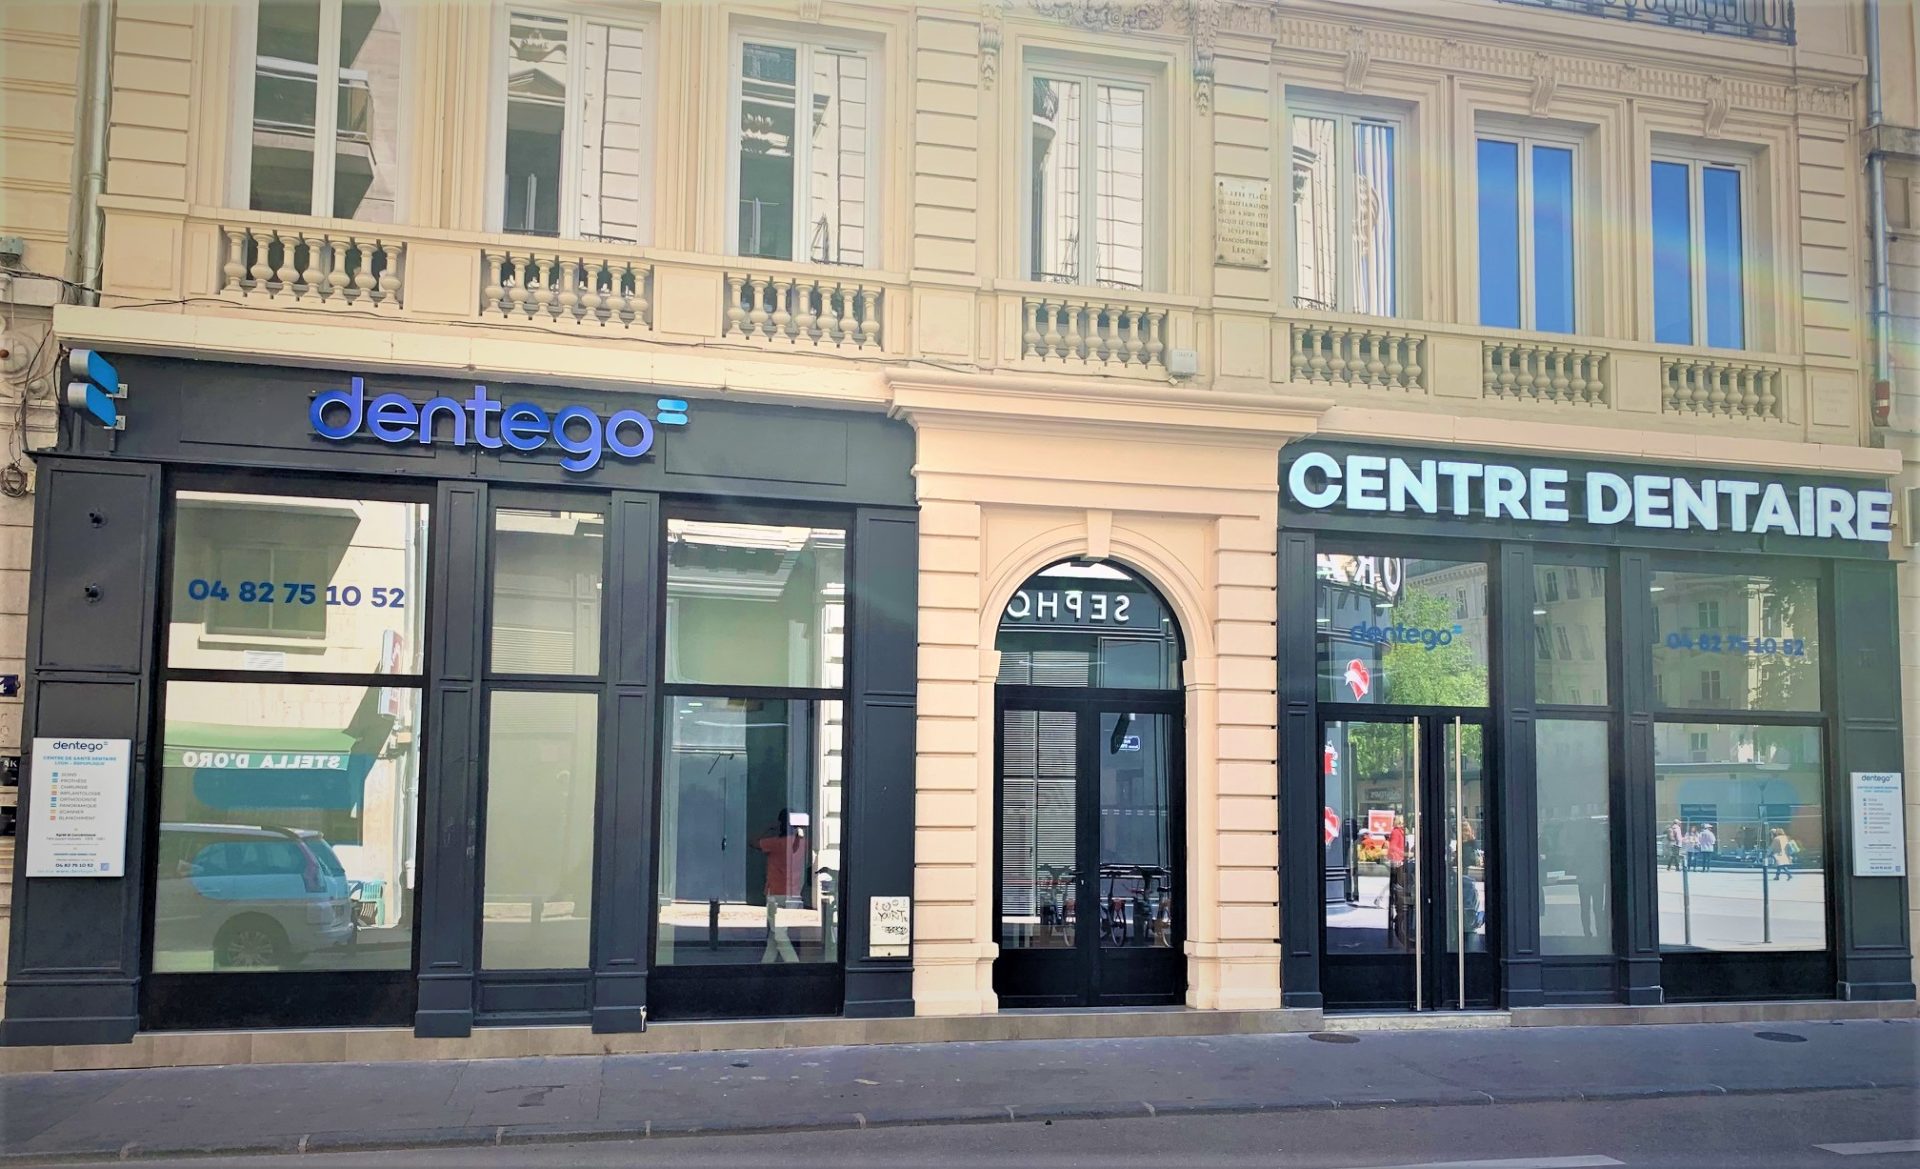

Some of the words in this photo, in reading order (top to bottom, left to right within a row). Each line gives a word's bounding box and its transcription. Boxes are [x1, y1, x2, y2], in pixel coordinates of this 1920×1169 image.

[308, 376, 655, 473] dentego
[1288, 451, 1570, 522] CENTRE
[1586, 472, 1893, 542] DENTAIRE
[188, 579, 229, 601] 04
[239, 581, 274, 603] 82
[283, 583, 316, 605] 75
[326, 585, 362, 606] 10
[371, 587, 405, 608] 52
[1350, 621, 1453, 651] dentego
[1667, 633, 1693, 650] 04
[1700, 634, 1721, 652] 82
[1728, 635, 1750, 653] 75
[1753, 637, 1777, 654] 10
[1783, 638, 1804, 656] 52
[53, 741, 103, 752] dentego
[1861, 775, 1891, 783] dentego
